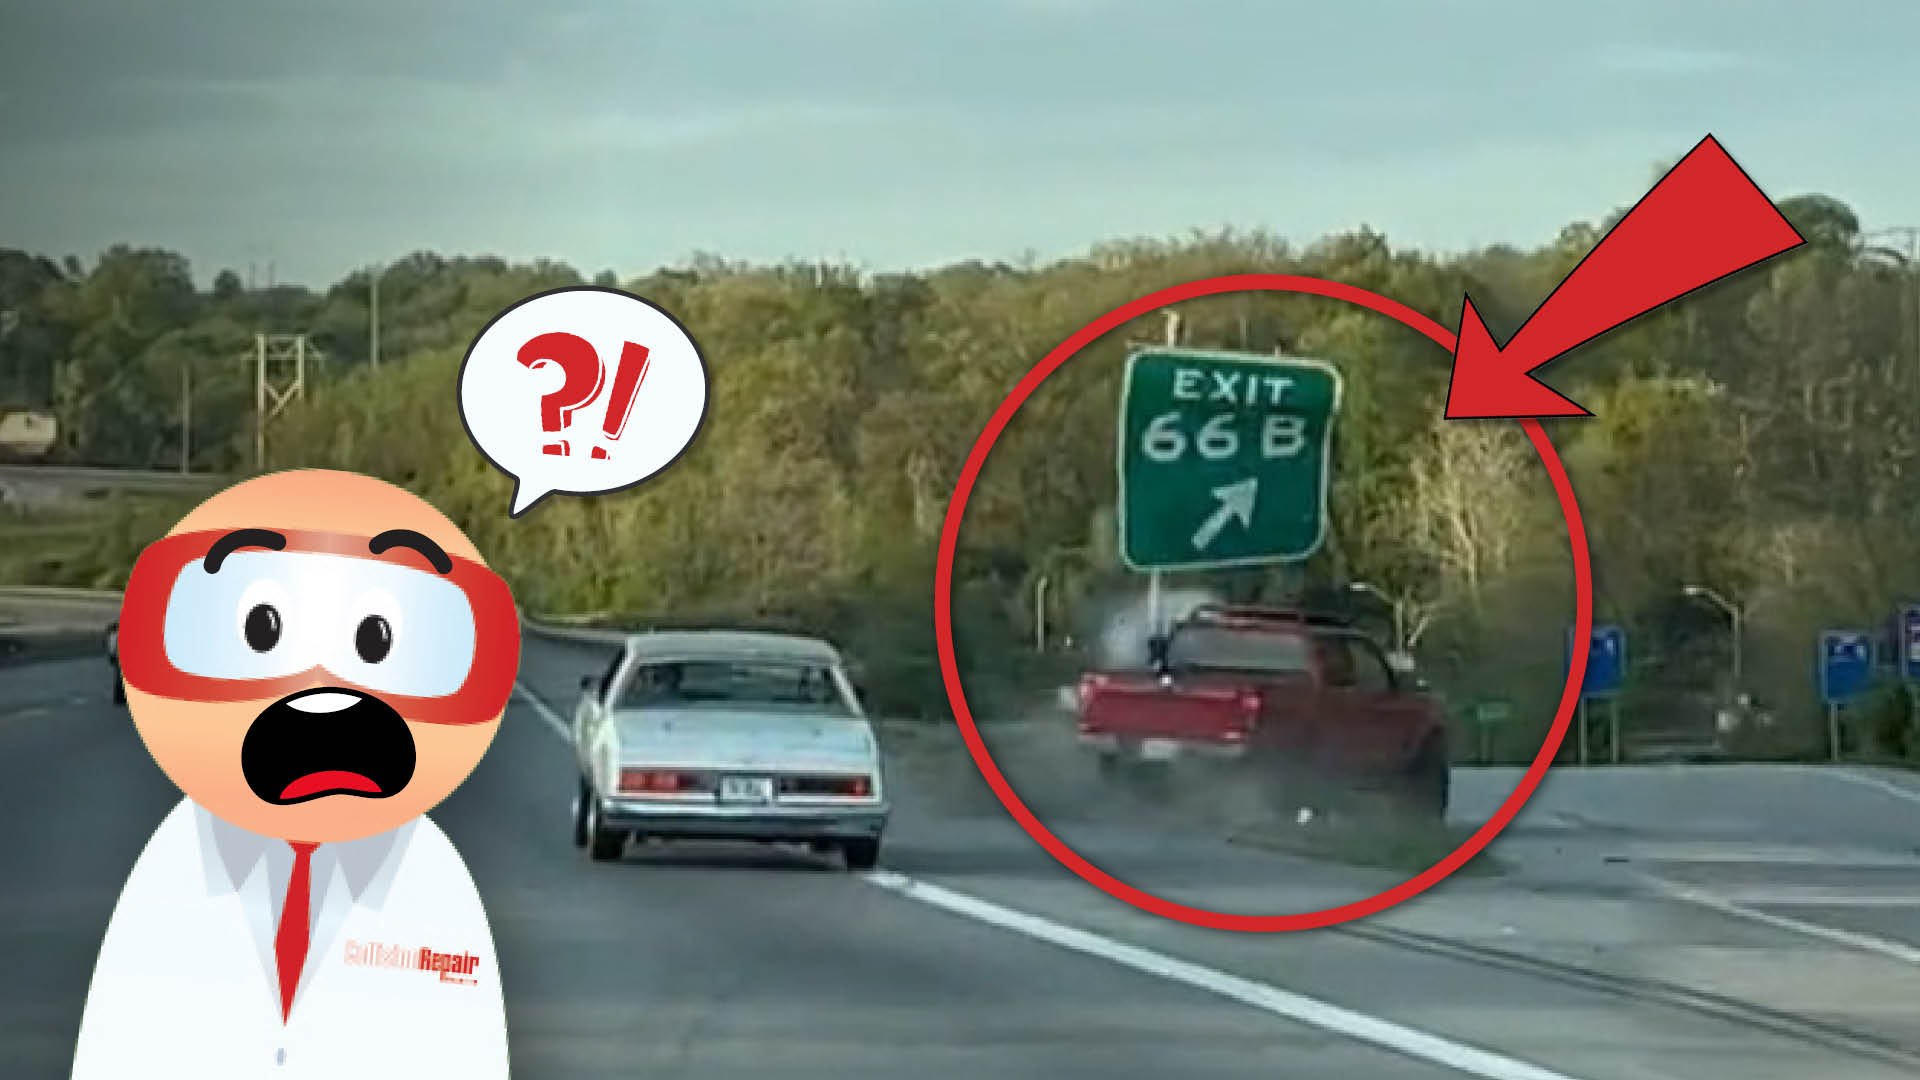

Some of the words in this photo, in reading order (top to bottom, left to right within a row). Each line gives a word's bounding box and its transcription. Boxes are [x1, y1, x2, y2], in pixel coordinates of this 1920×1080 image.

[1173, 367, 1295, 405] EXIT
[1141, 411, 1239, 462] 66
[1262, 413, 1306, 459] B
